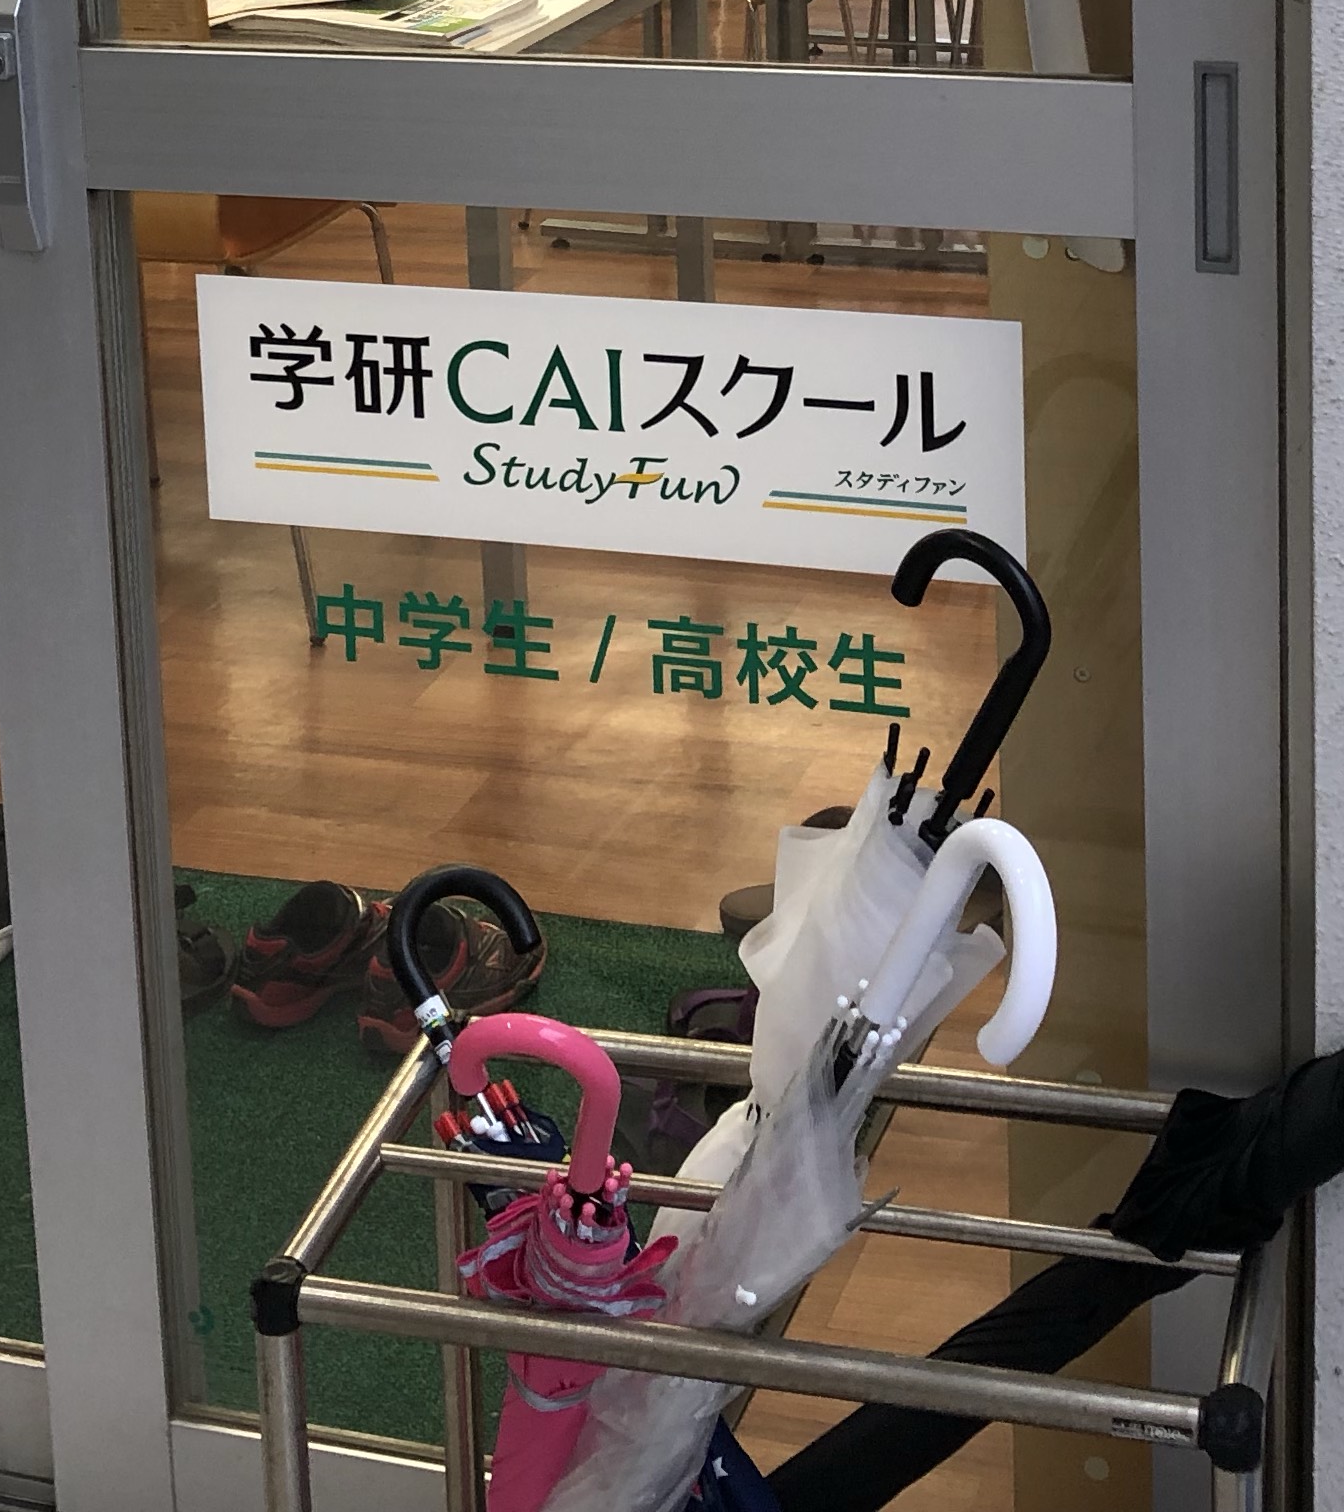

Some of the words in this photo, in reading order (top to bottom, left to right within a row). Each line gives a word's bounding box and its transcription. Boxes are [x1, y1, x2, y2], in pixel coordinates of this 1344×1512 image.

[249, 322, 967, 453] 学研CAIスクール
[835, 468, 967, 496] スタディファン
